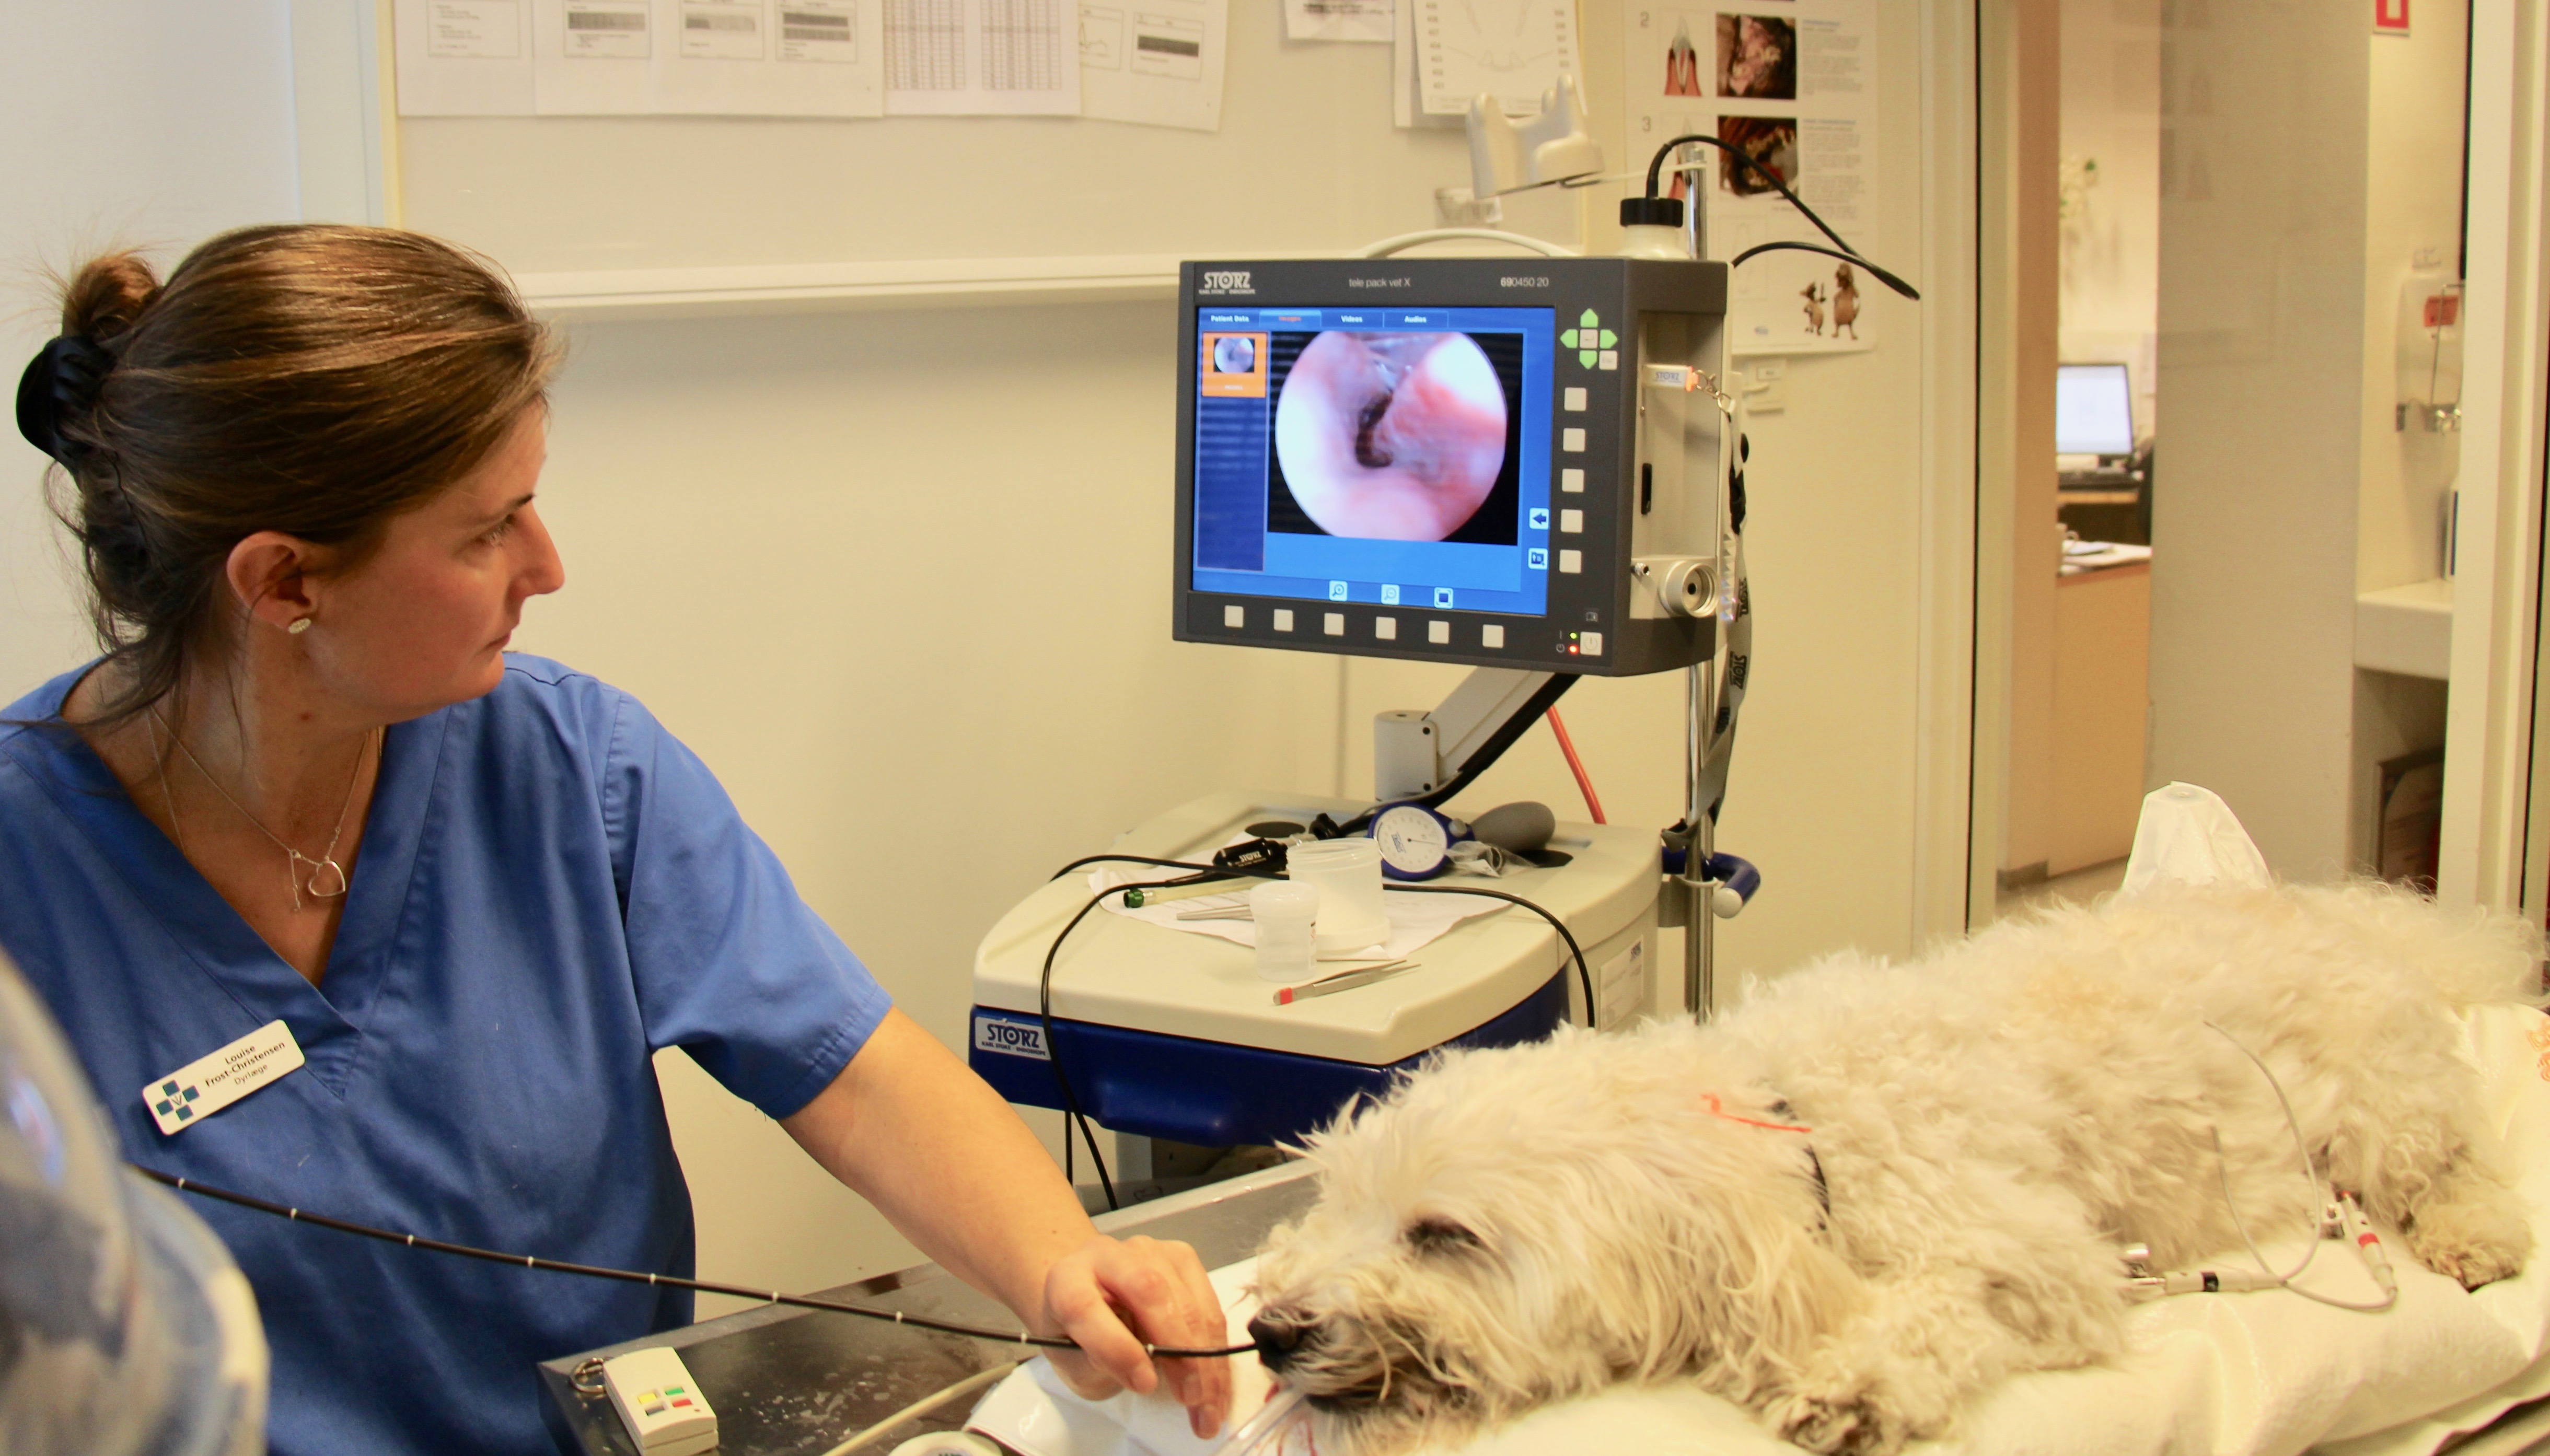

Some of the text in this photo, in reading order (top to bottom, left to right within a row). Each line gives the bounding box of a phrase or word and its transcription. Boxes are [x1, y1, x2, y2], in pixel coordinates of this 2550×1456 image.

[1640, 13, 1650, 28] 2
[1642, 117, 1651, 132] 3
[1204, 271, 1250, 289] STORZ
[1349, 277, 1410, 288] tele pack vet X
[1500, 276, 1549, 288] 690450 20
[1733, 654, 1747, 690] STORZ
[1239, 851, 1262, 863] STORZ
[987, 1023, 1040, 1049] STORZ
[225, 1045, 256, 1065] Louise
[205, 1042, 285, 1087] Frost-Christensen
[235, 1065, 268, 1085] Dyrlæge
